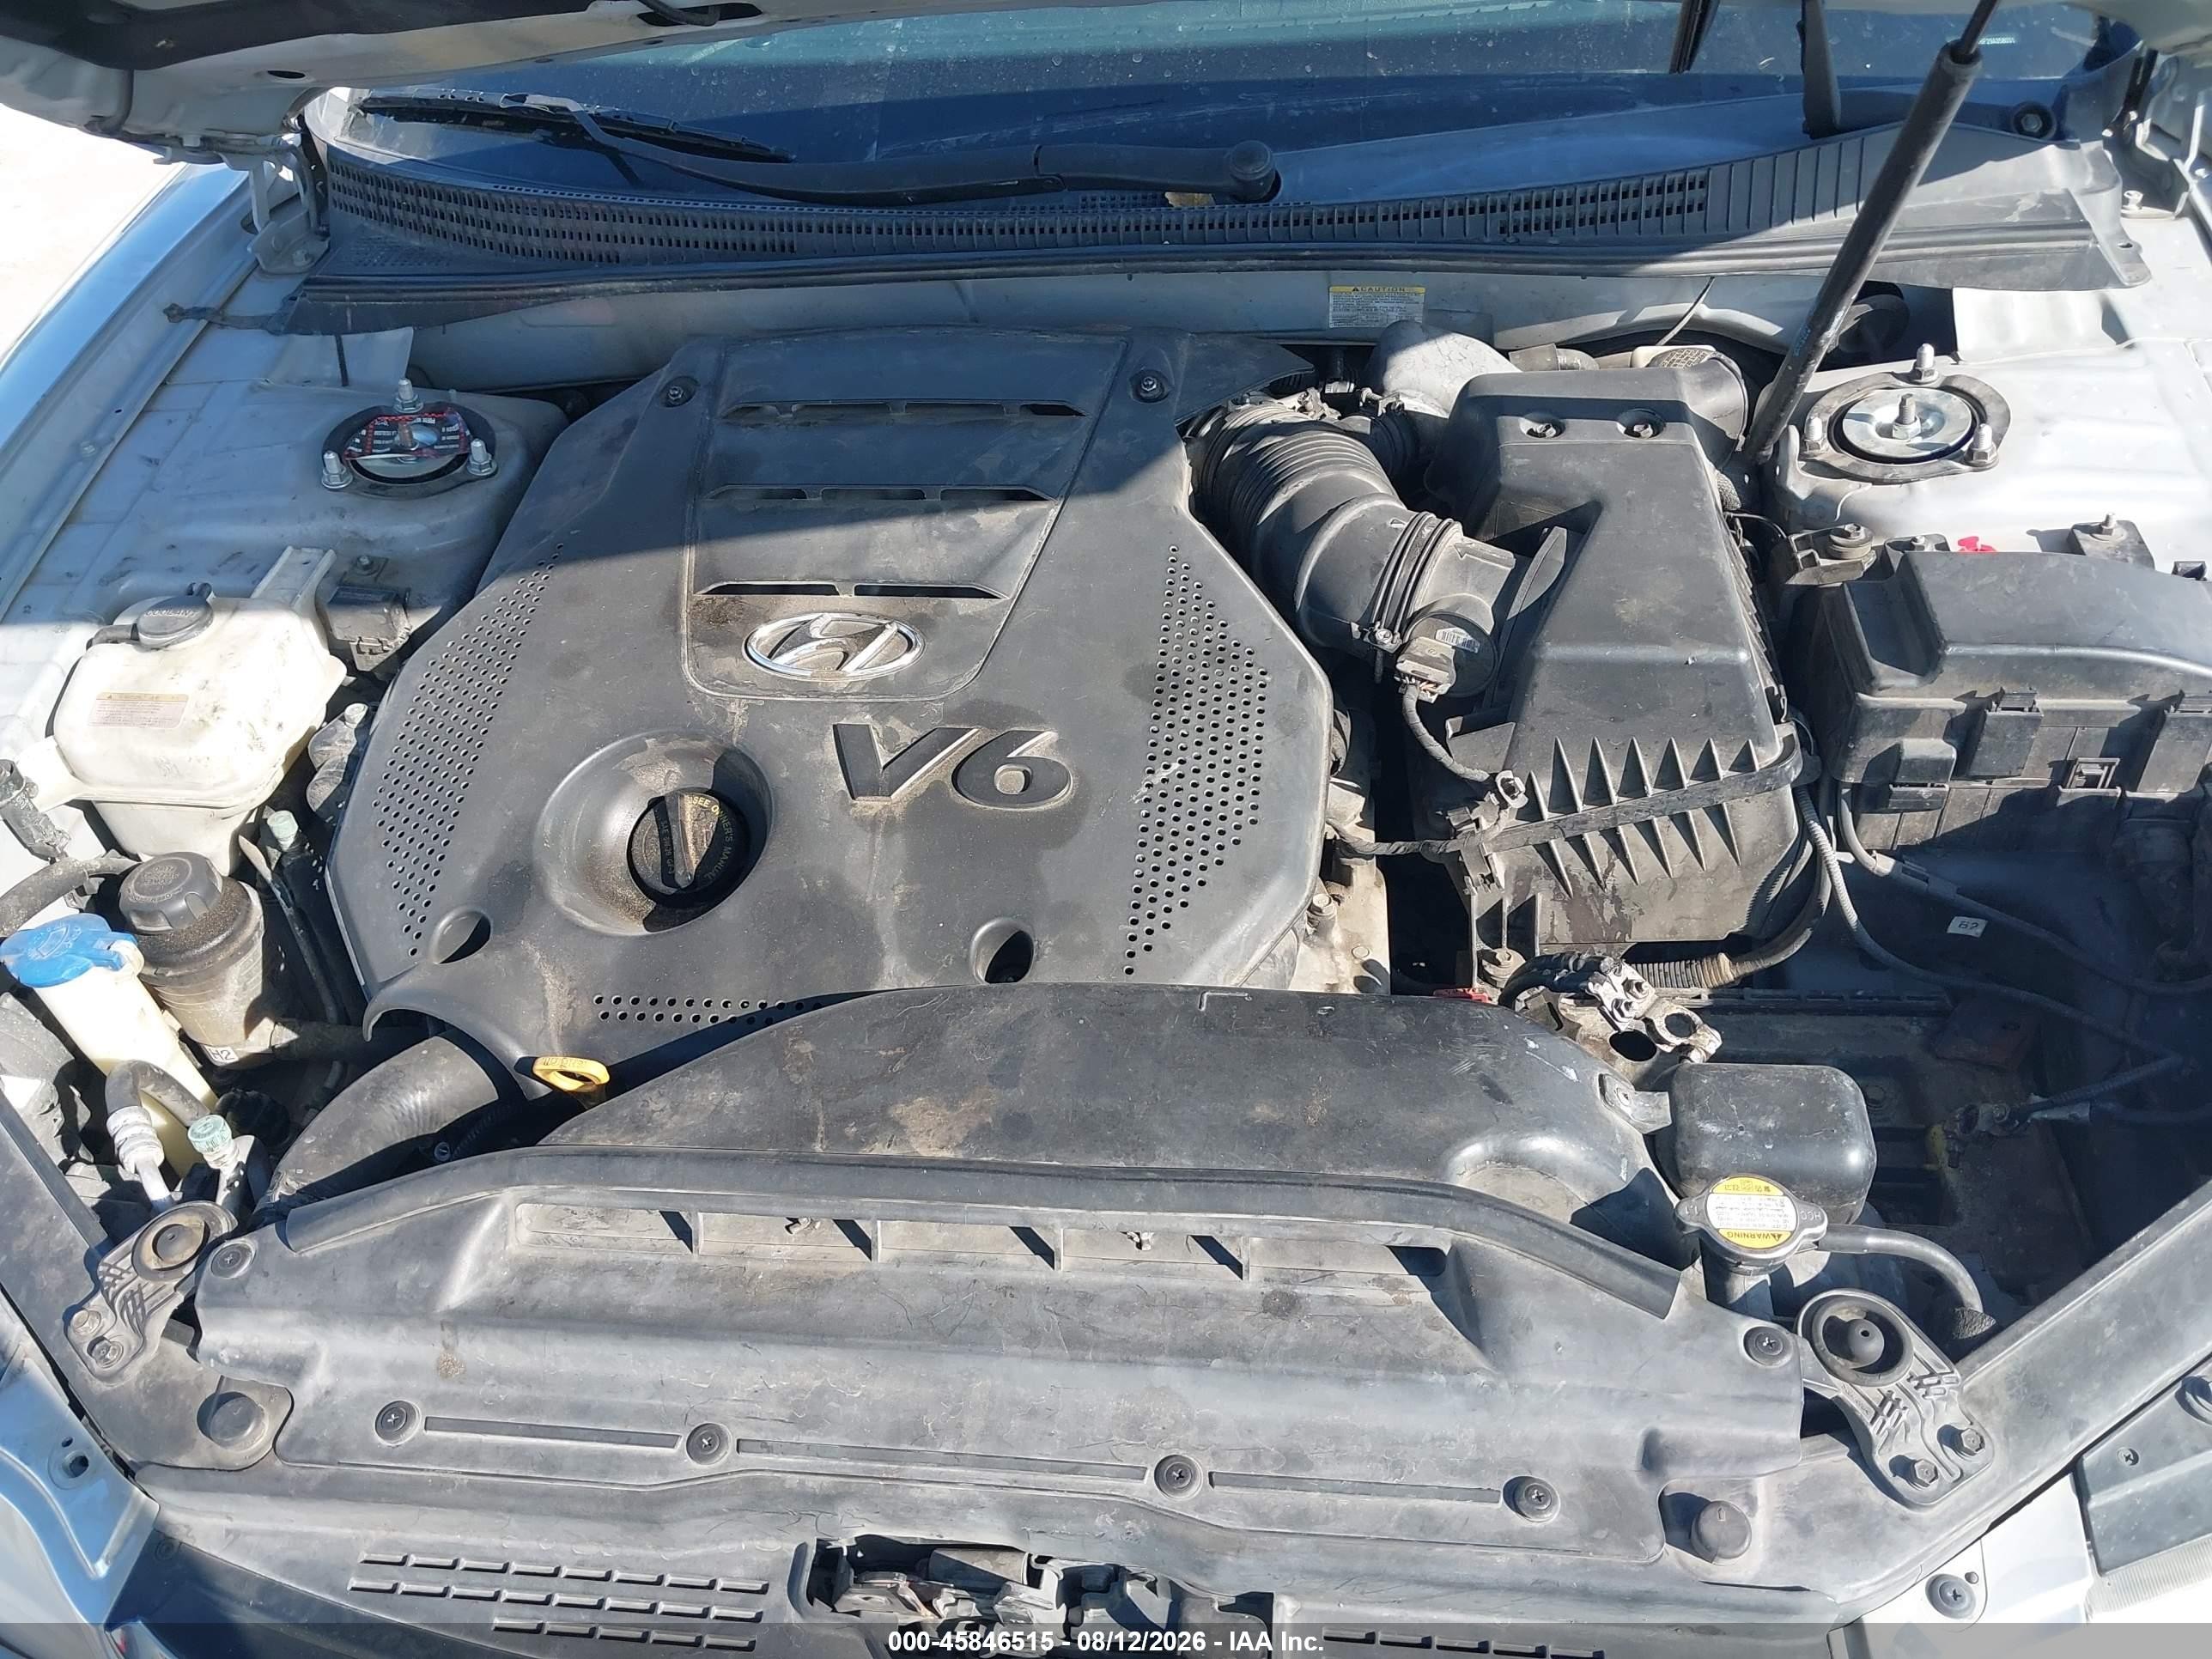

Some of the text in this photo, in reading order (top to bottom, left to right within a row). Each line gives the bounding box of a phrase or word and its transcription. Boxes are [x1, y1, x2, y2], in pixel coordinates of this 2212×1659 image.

[832, 722, 1075, 811] V6
[692, 796, 735, 880] SEE OWNER'S MANUAL
[209, 1048, 235, 1060] H2
